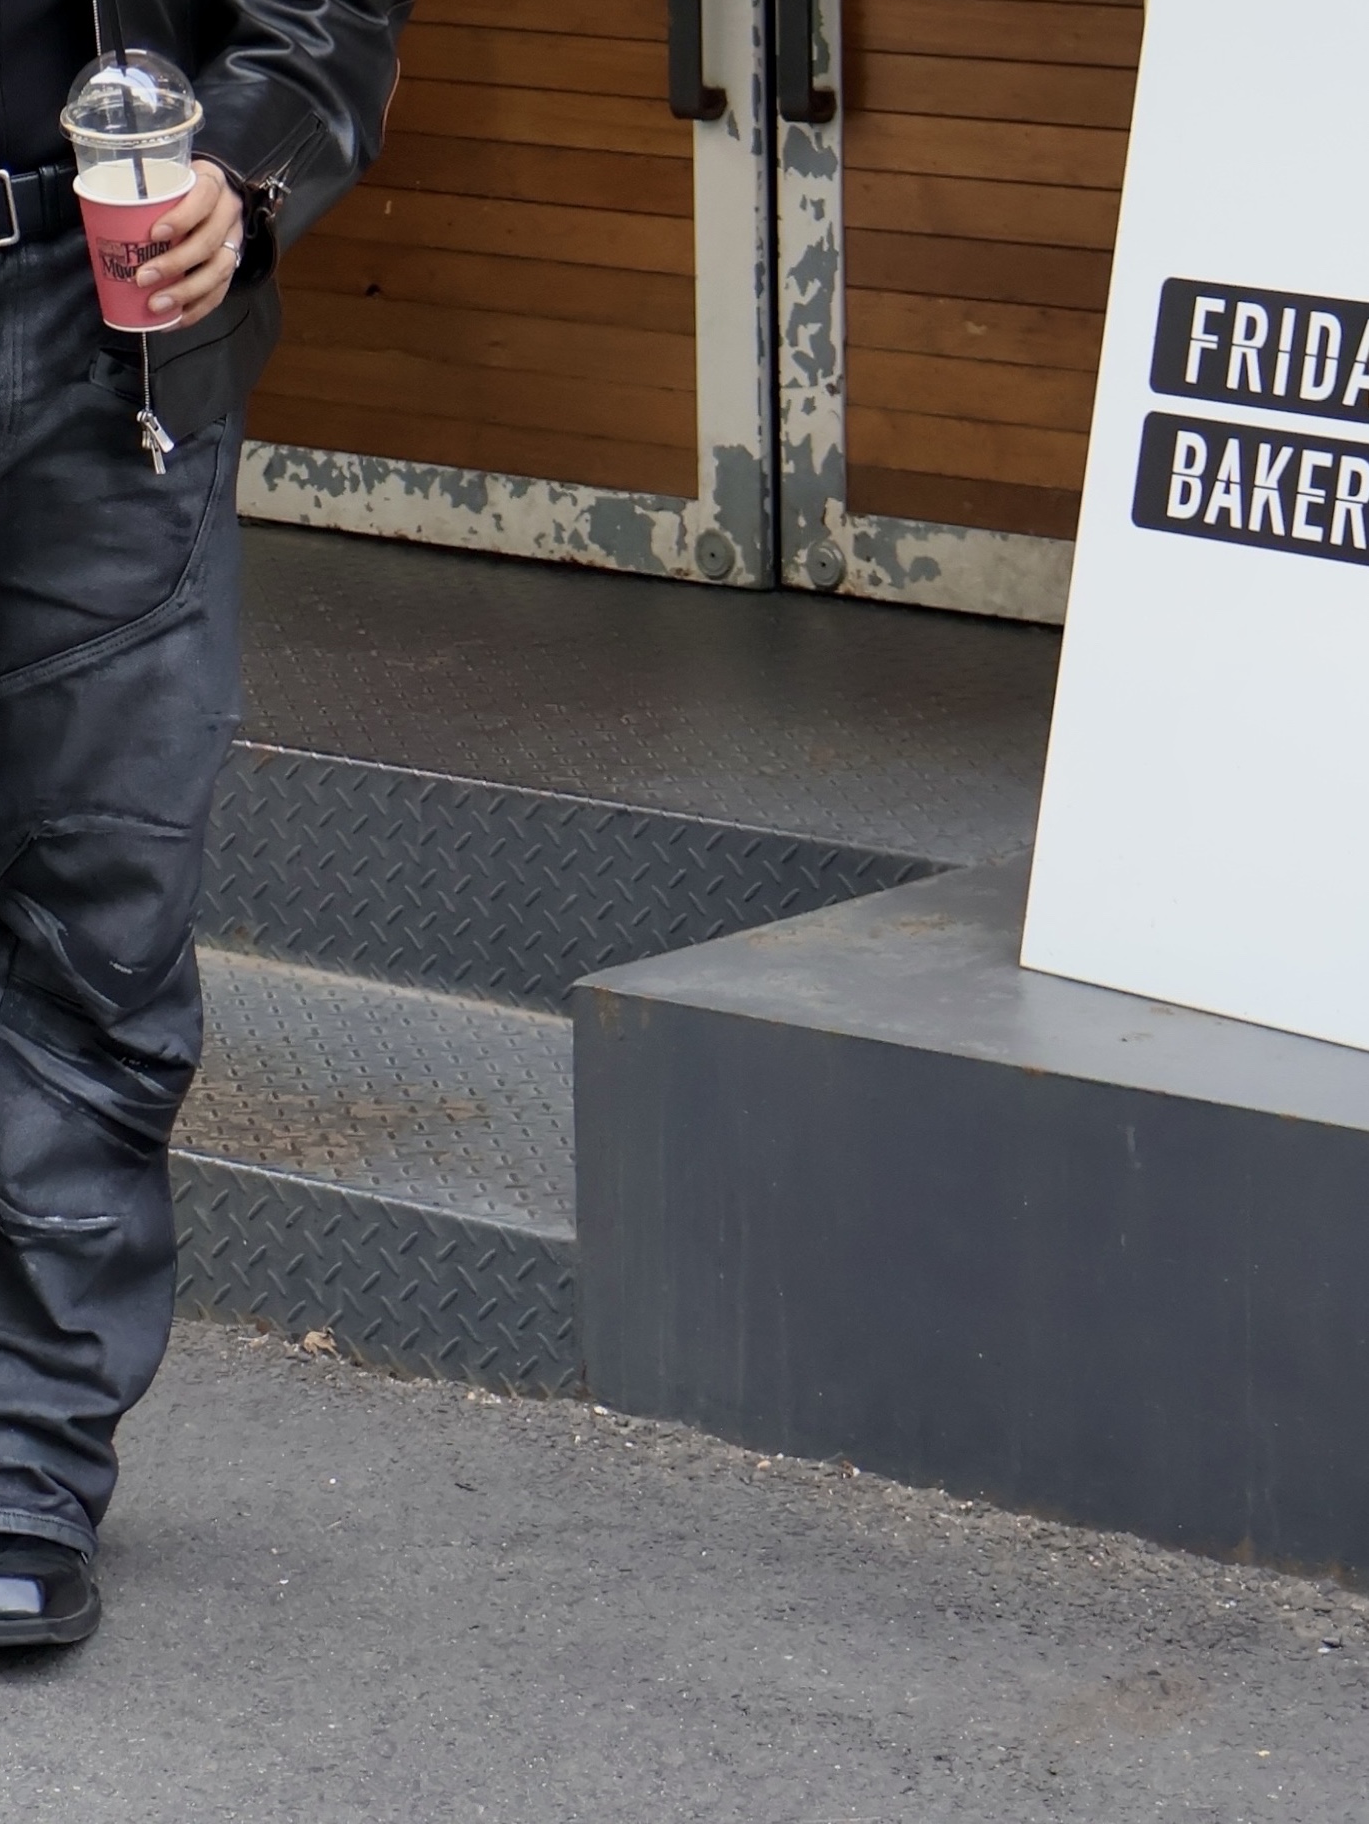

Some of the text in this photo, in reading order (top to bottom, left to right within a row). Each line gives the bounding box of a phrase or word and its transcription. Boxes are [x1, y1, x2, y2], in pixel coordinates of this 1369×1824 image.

[120, 241, 172, 266] FRIDAY
[101, 255, 137, 282] MOV
[1166, 429, 1369, 551] BAKER
